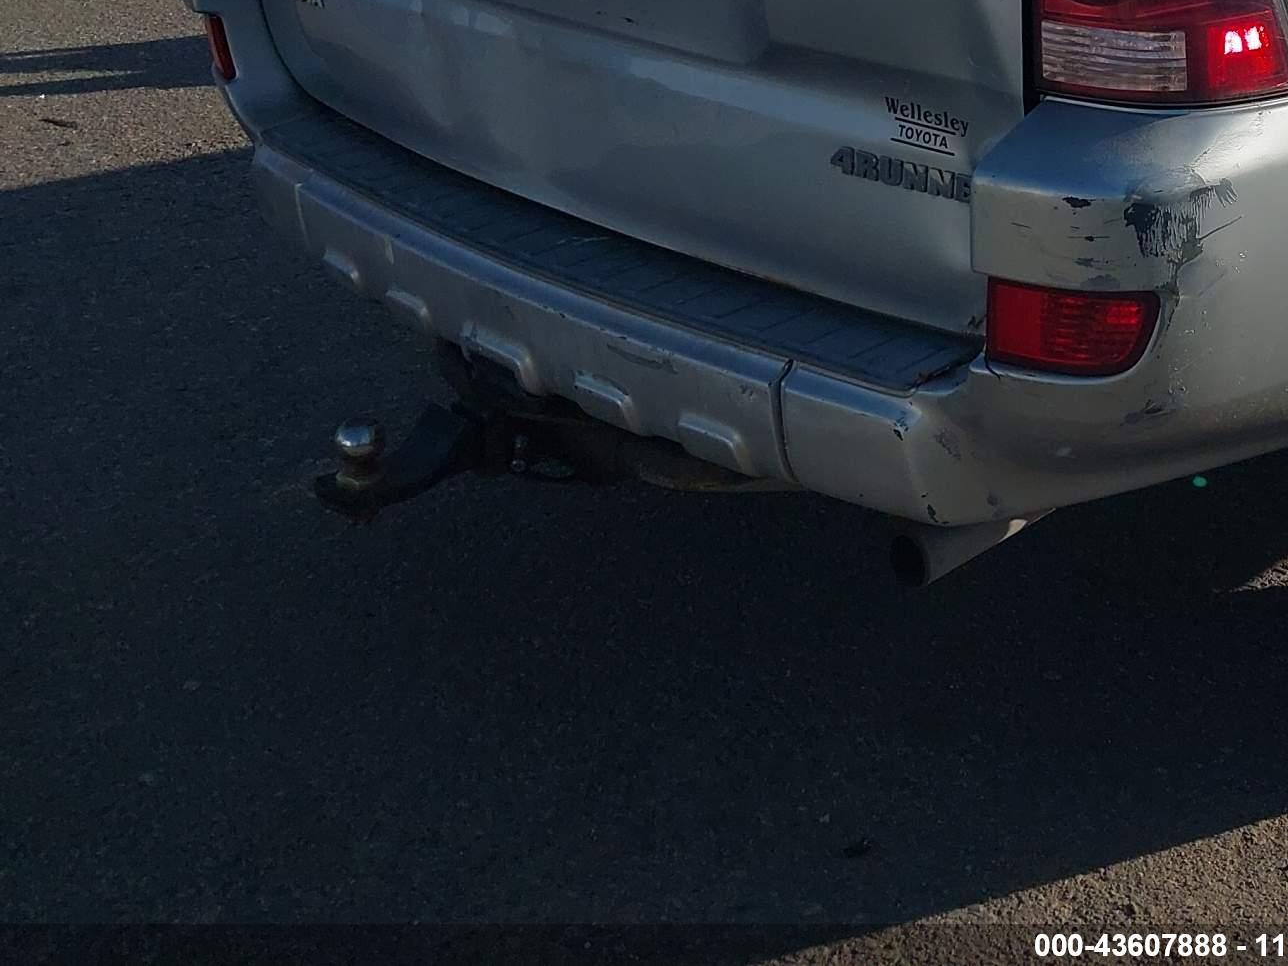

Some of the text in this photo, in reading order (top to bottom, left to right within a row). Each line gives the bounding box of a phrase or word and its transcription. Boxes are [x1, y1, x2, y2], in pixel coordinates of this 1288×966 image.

[884, 96, 969, 137] Wellesley
[899, 124, 948, 149] TOYOTA
[830, 146, 972, 203] 4RUNNE
